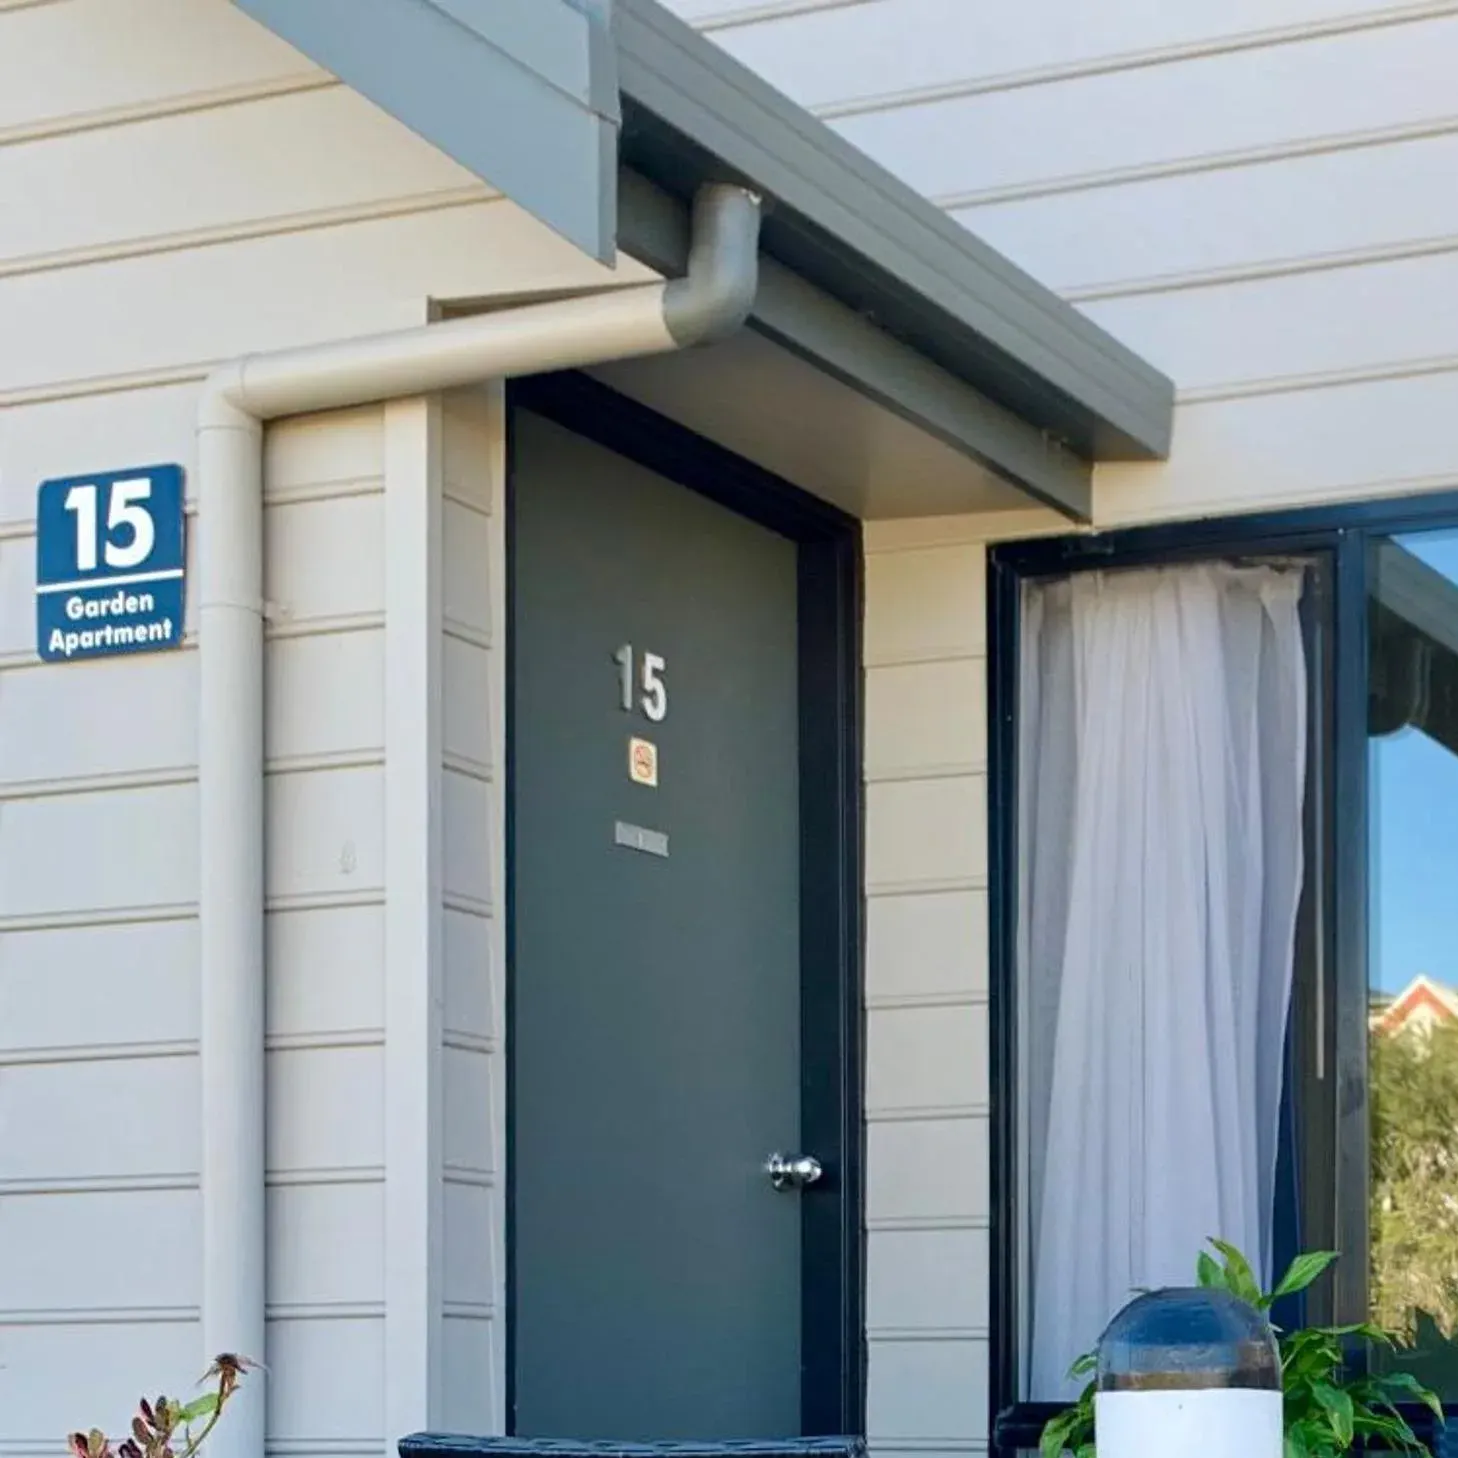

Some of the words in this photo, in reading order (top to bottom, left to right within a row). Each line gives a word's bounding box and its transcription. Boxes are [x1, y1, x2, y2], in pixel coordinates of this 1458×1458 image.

[64, 477, 155, 571] 15
[66, 590, 154, 619] Garden
[49, 618, 173, 656] Apartment
[616, 645, 667, 721] 15
